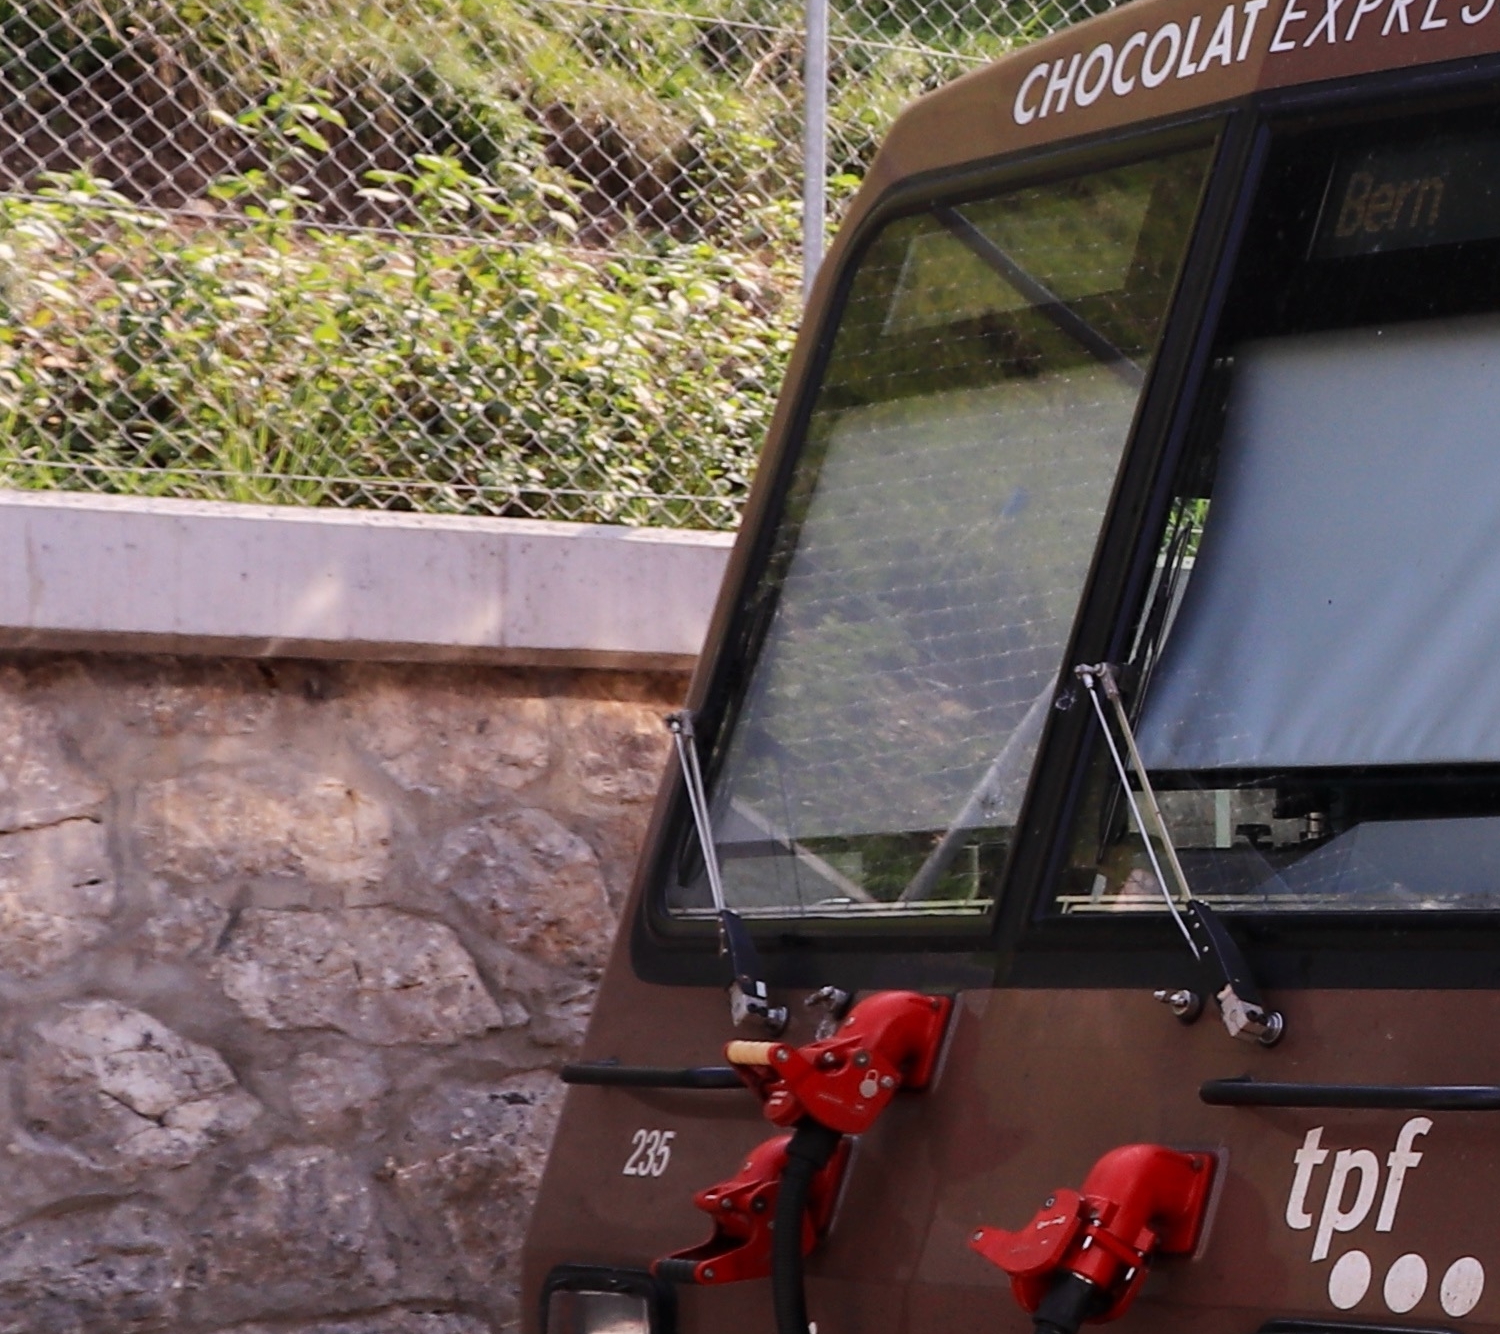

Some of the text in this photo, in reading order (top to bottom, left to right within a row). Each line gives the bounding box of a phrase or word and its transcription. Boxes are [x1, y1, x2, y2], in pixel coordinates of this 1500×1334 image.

[1333, 171, 1446, 239] Bern
[622, 1128, 675, 1179] 235
[1284, 1116, 1433, 1262] tpf
